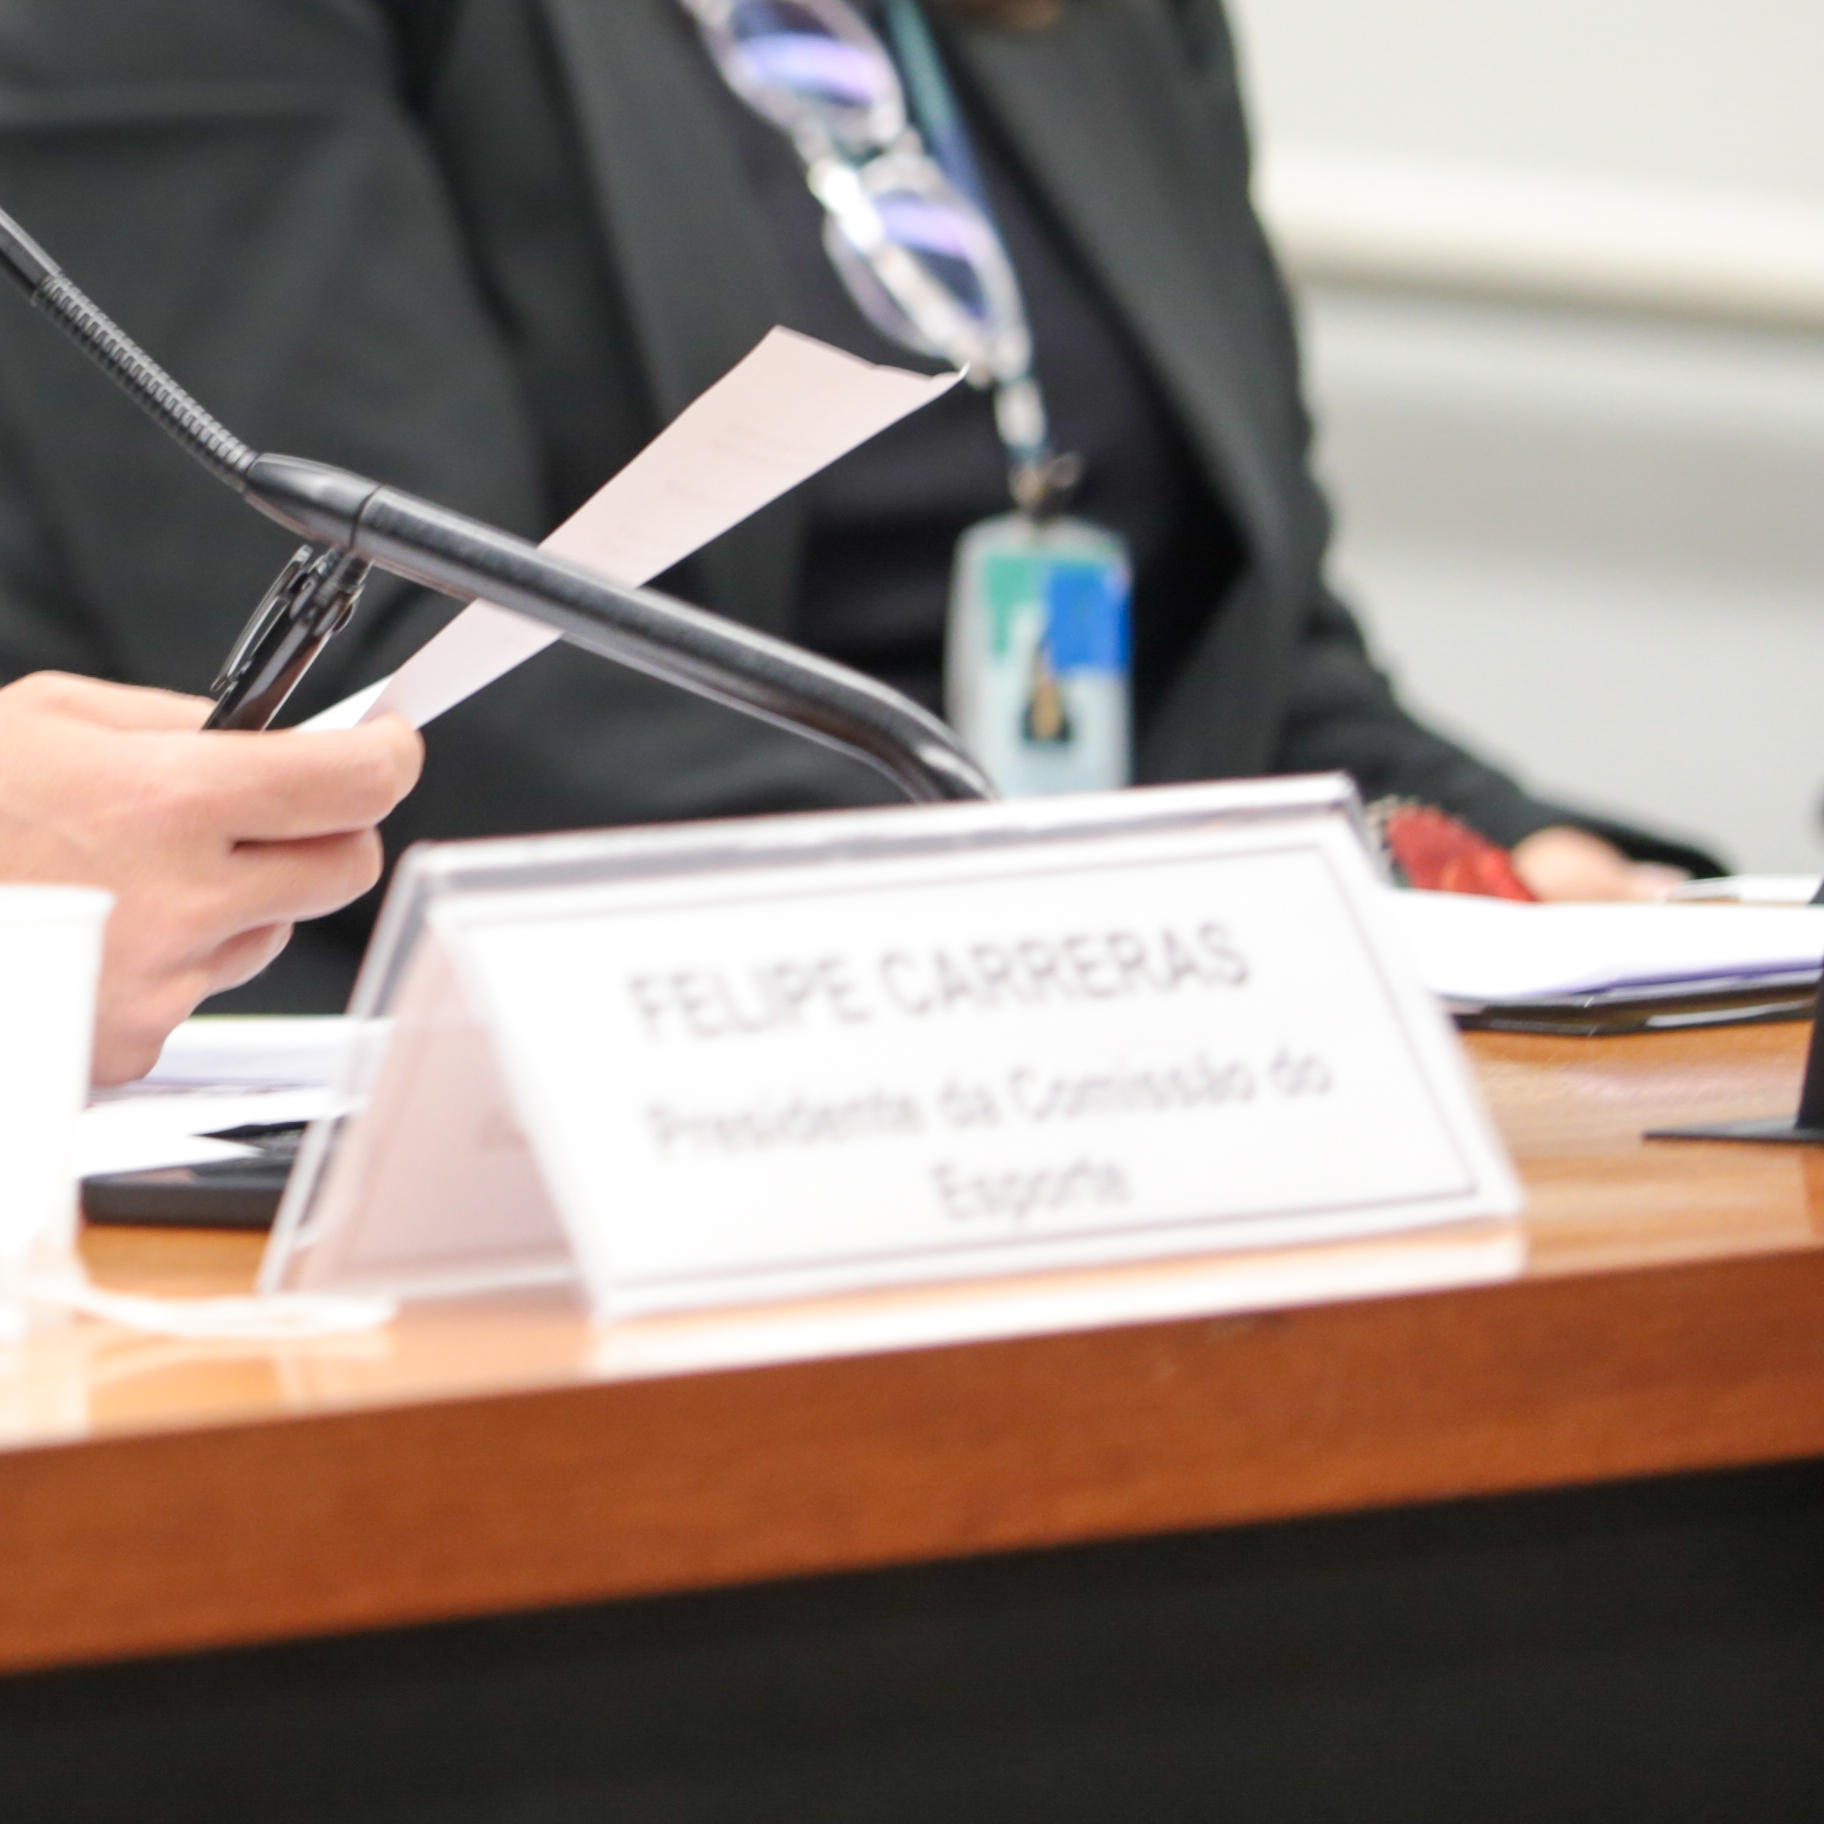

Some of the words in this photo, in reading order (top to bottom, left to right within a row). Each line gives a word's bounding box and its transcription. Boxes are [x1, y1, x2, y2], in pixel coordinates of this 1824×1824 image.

[626, 954, 871, 1043] FELIPE
[881, 919, 1252, 1020] CARRERAS
[646, 1082, 925, 1157] Presidente
[940, 1066, 1000, 1127] da
[1010, 1049, 1259, 1124] Comissão
[1272, 1038, 1334, 1099] do
[932, 1154, 1131, 1231] Esporte
